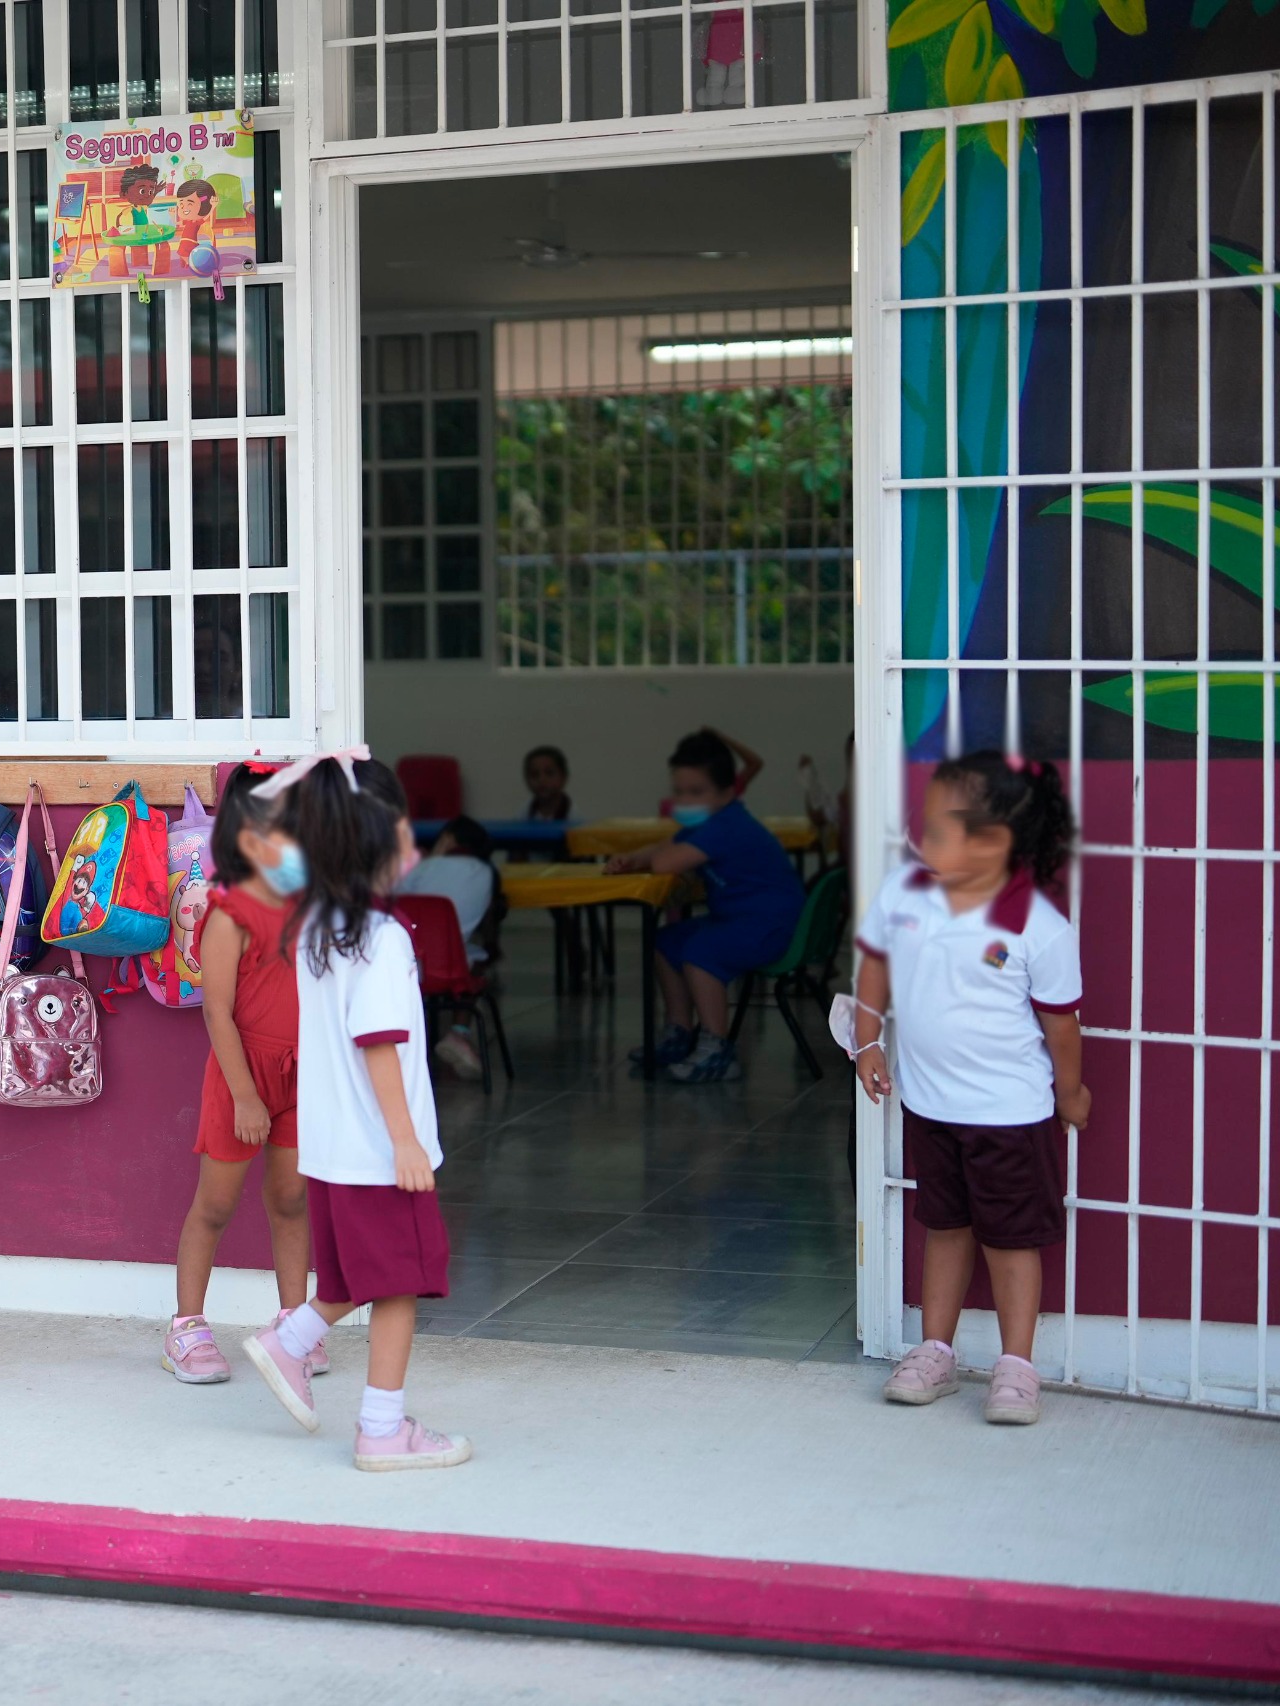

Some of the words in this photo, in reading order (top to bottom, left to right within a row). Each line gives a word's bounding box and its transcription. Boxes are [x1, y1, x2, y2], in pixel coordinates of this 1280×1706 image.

[65, 127, 182, 164] Segundo
[189, 124, 209, 150] B
[213, 132, 235, 147] TM
